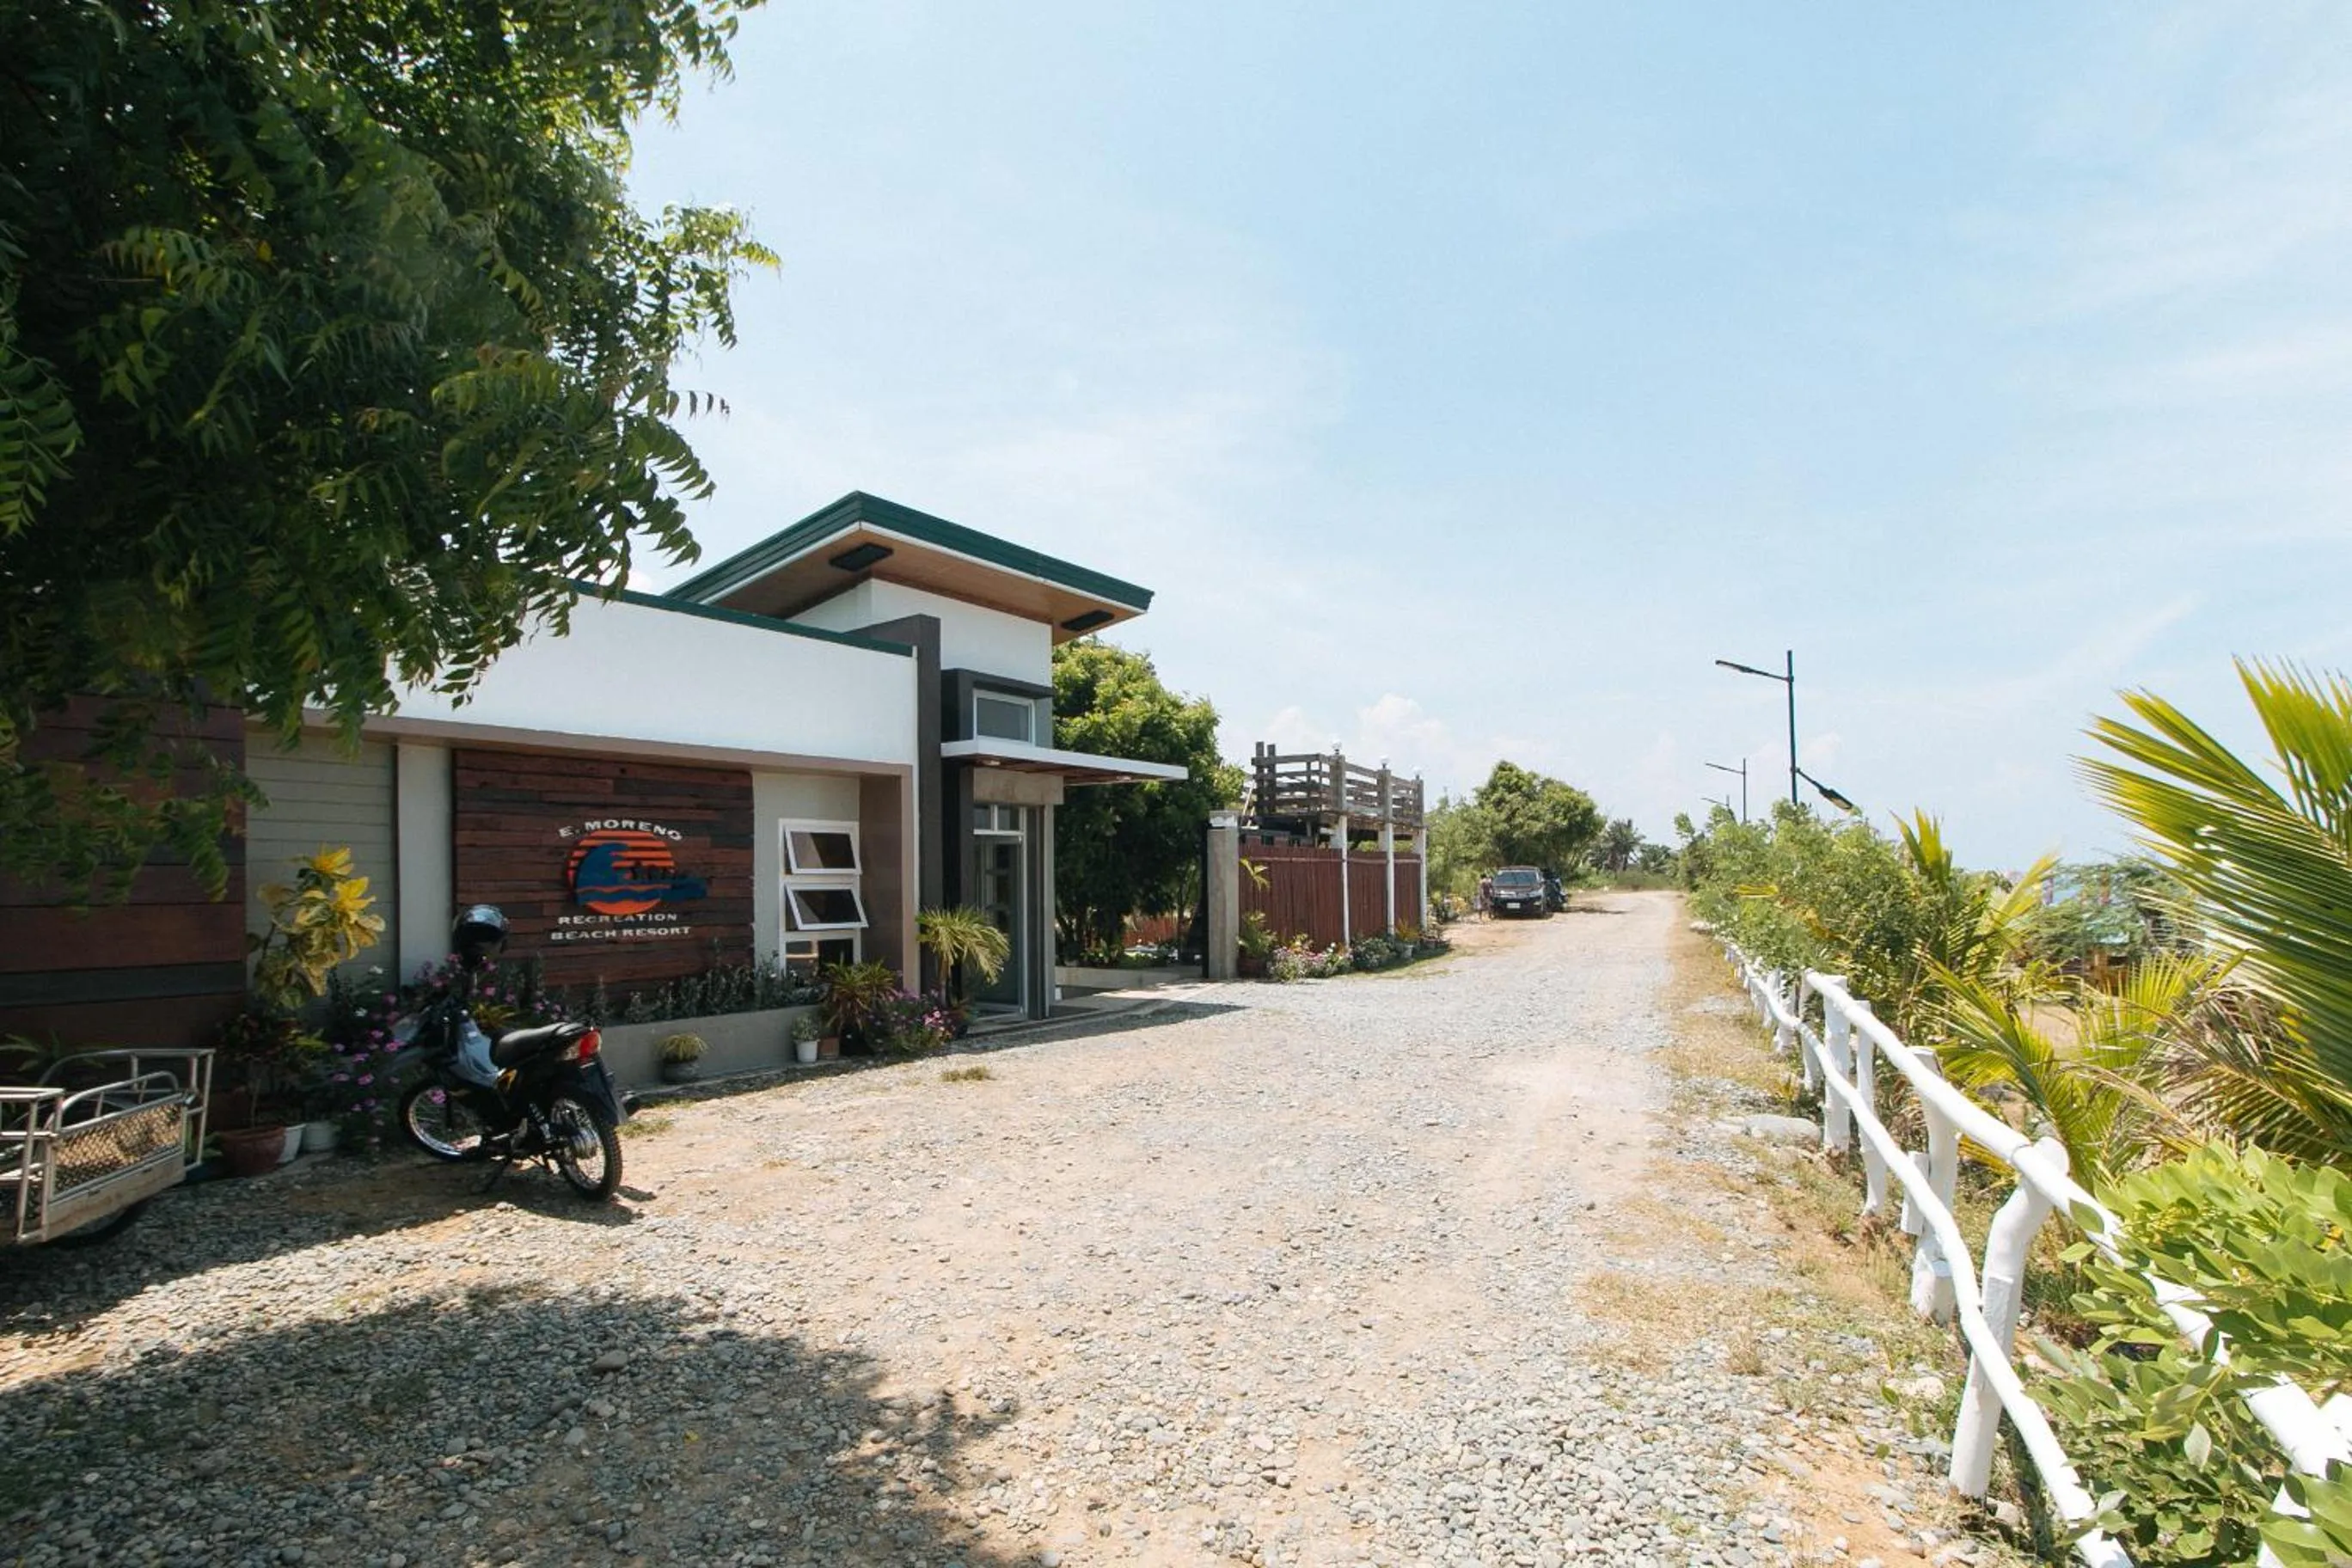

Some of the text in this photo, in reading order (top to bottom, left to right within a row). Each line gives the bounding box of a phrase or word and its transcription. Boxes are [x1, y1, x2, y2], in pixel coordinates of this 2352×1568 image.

[585, 819, 683, 841] MORENO
[558, 913, 677, 925] RECREATION
[551, 927, 691, 940] BEACH RESORT
